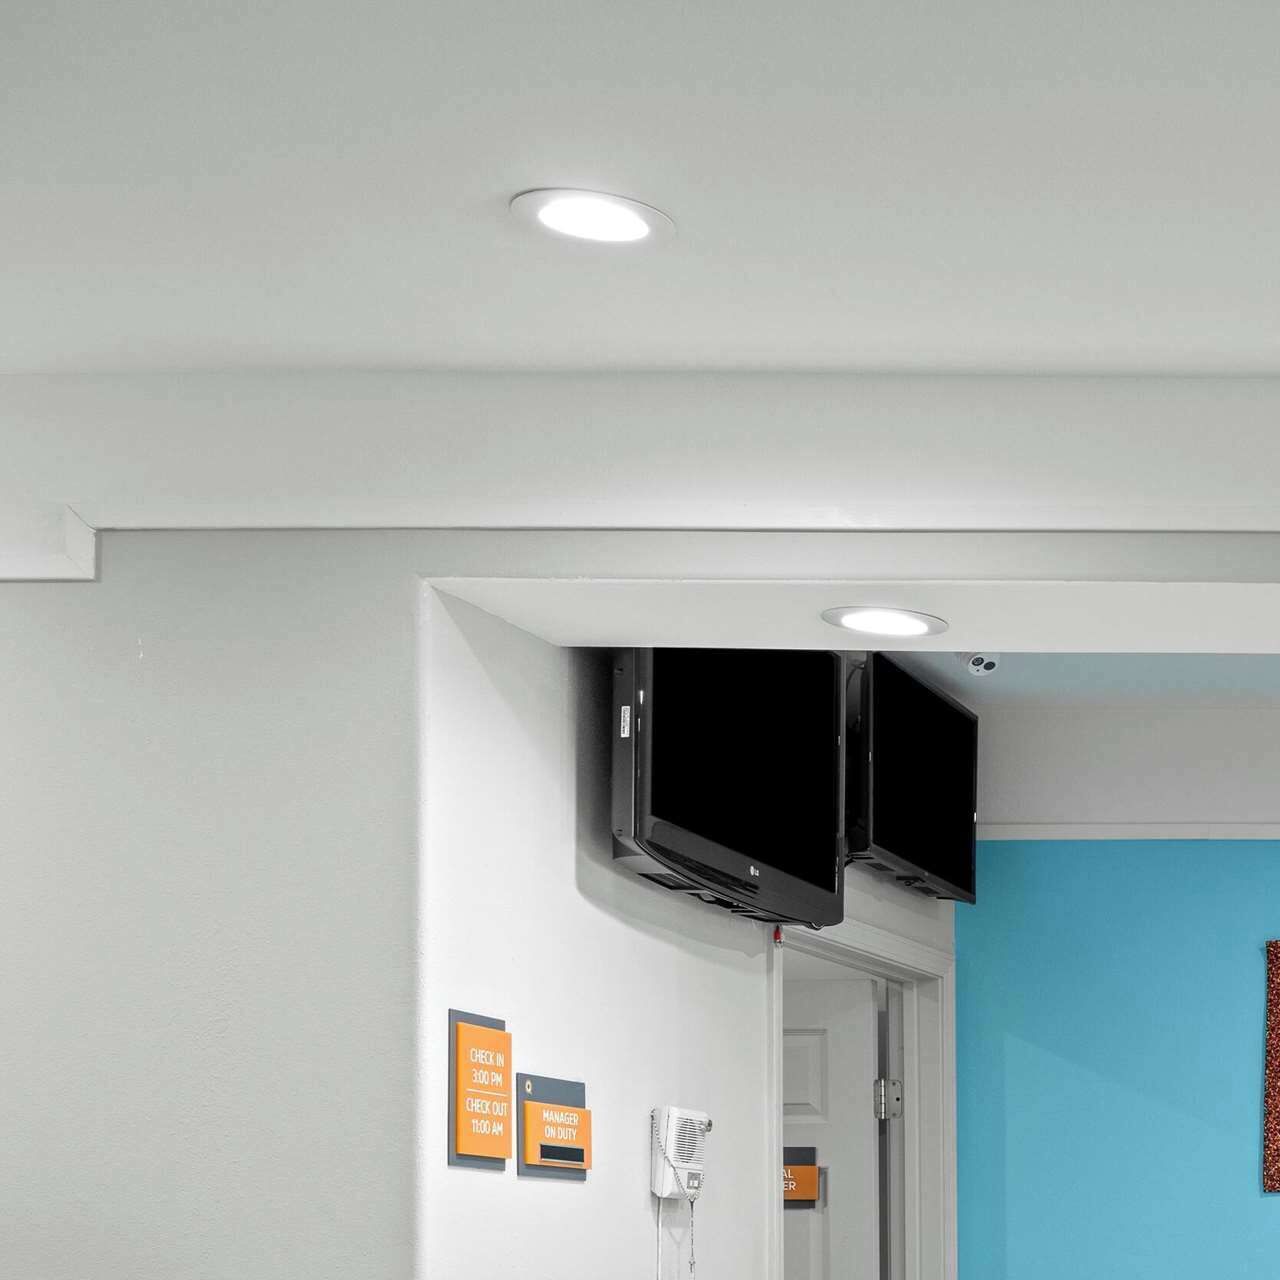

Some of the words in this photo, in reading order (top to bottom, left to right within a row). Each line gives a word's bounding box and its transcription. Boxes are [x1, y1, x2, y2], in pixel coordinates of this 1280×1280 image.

[470, 1048, 495, 1064] CHECK
[496, 1052, 504, 1067] IN
[472, 1068, 489, 1085] 3:00
[491, 1072, 503, 1087] PM
[466, 1098, 490, 1114] CHECK
[492, 1101, 507, 1117] OUT
[543, 1109, 579, 1125] MANAGER
[472, 1119, 490, 1135] 11:00
[492, 1121, 503, 1136] AM
[544, 1125, 555, 1138] ON
[557, 1127, 577, 1140] DUTY
